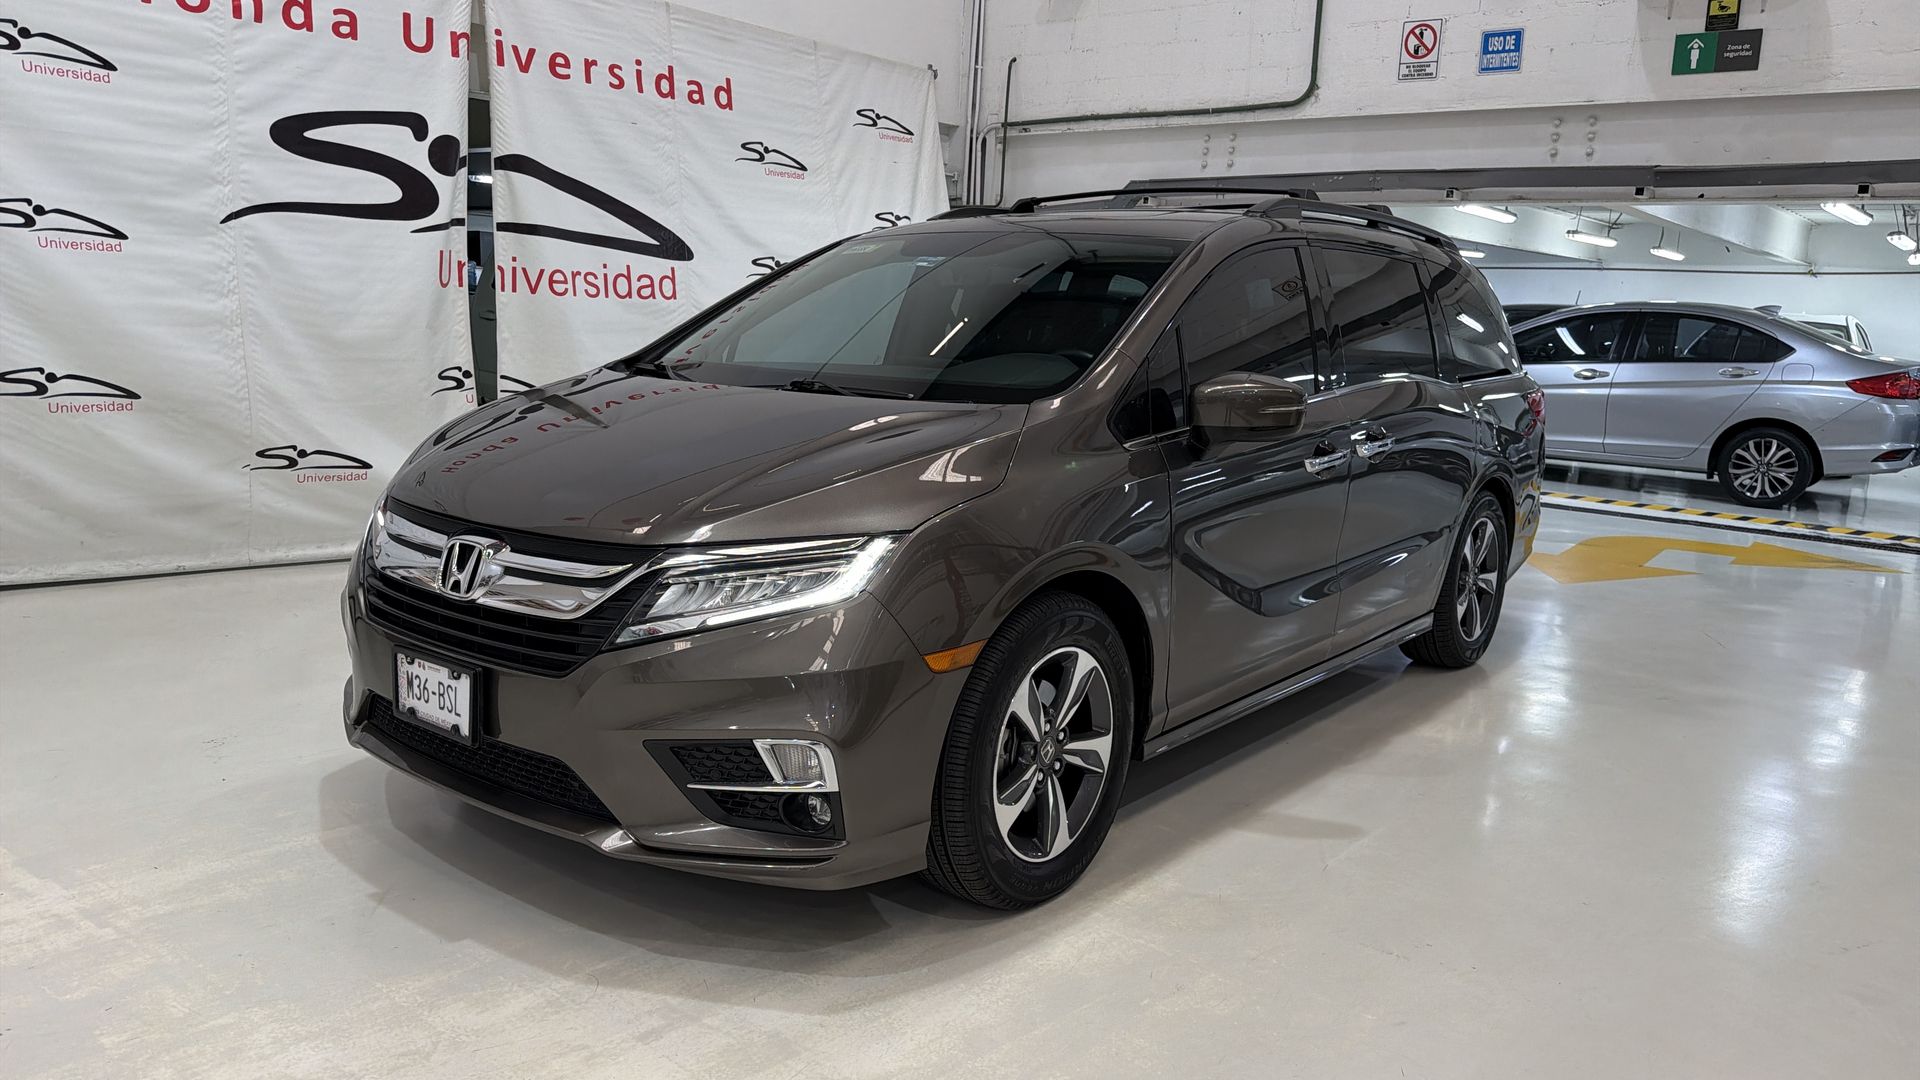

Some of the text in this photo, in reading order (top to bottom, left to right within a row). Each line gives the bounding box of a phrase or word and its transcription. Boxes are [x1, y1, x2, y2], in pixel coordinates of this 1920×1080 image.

[1488, 35, 1516, 51] USO DE
[1723, 50, 1752, 58] seguridad
[402, 11, 734, 112] Universidad
[21, 60, 112, 84] Universidad
[879, 132, 914, 144] Universidad
[764, 167, 805, 180] Universidad
[37, 236, 123, 253] Universidad
[47, 401, 134, 413] Universidad
[296, 471, 368, 484] Universidad
[406, 670, 461, 718] M36-BSL
